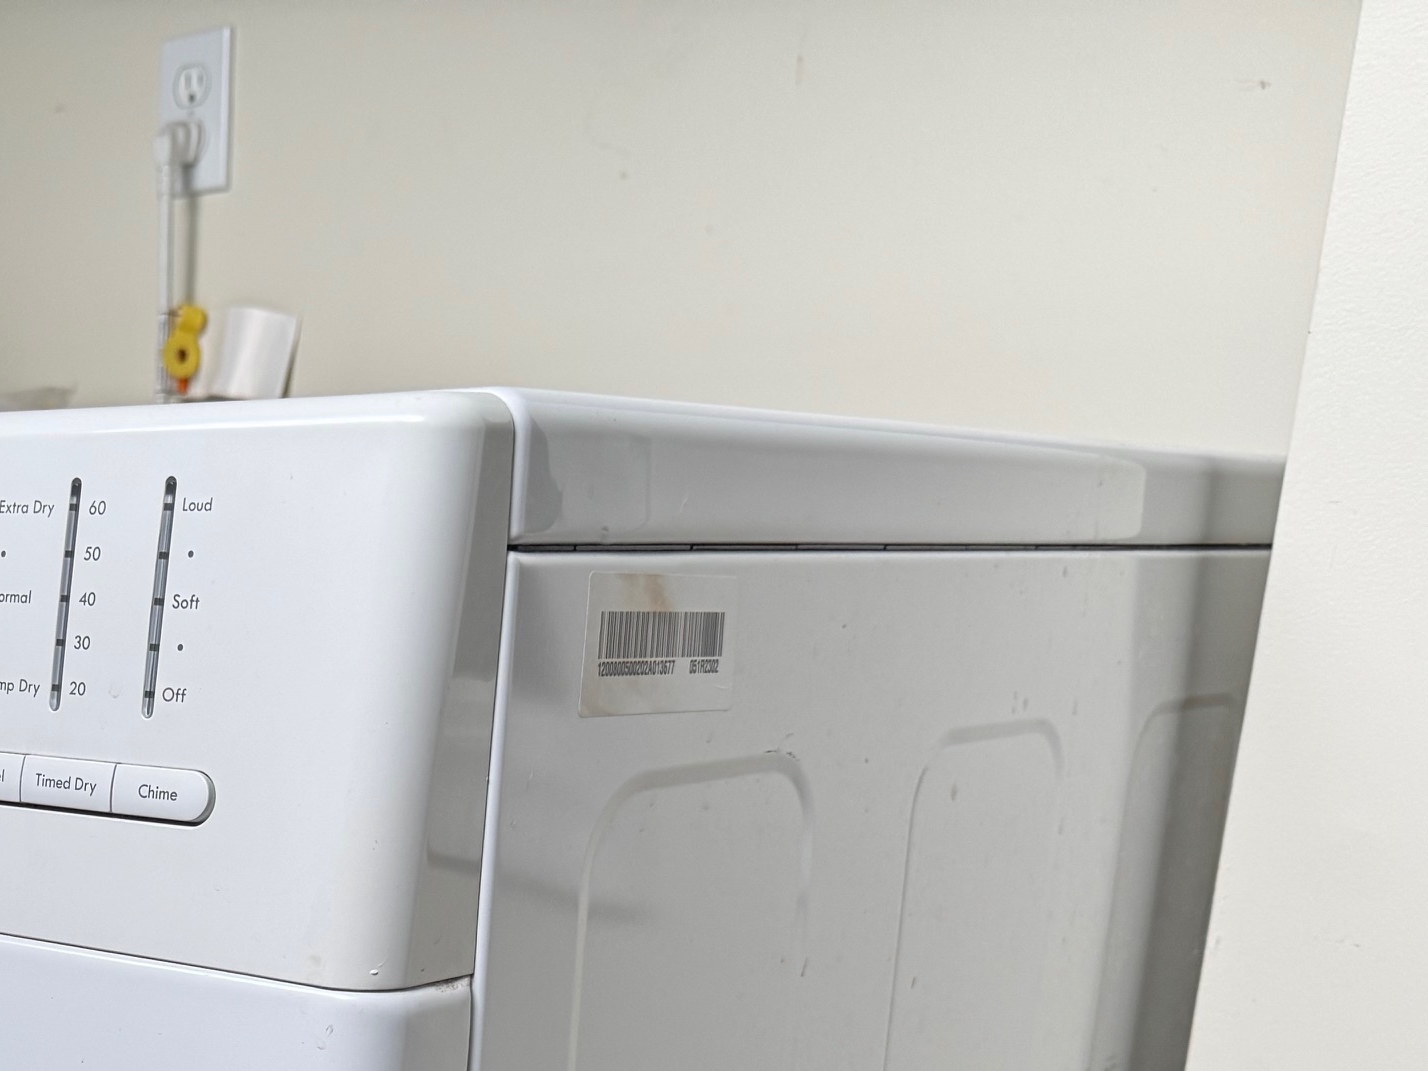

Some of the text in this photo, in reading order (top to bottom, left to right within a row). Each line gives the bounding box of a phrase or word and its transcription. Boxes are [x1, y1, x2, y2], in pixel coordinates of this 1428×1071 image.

[33, 501, 55, 518] Dry
[88, 500, 107, 516] 60
[182, 498, 213, 513] Loud
[83, 547, 102, 562] 50
[79, 592, 96, 607] 40
[172, 594, 200, 610] Soft
[73, 635, 91, 650] 30
[19, 679, 41, 698] Dry
[69, 681, 86, 696] 20
[162, 688, 187, 703] Off
[35, 773, 97, 797] Timed Dry
[138, 784, 178, 802] Chime
